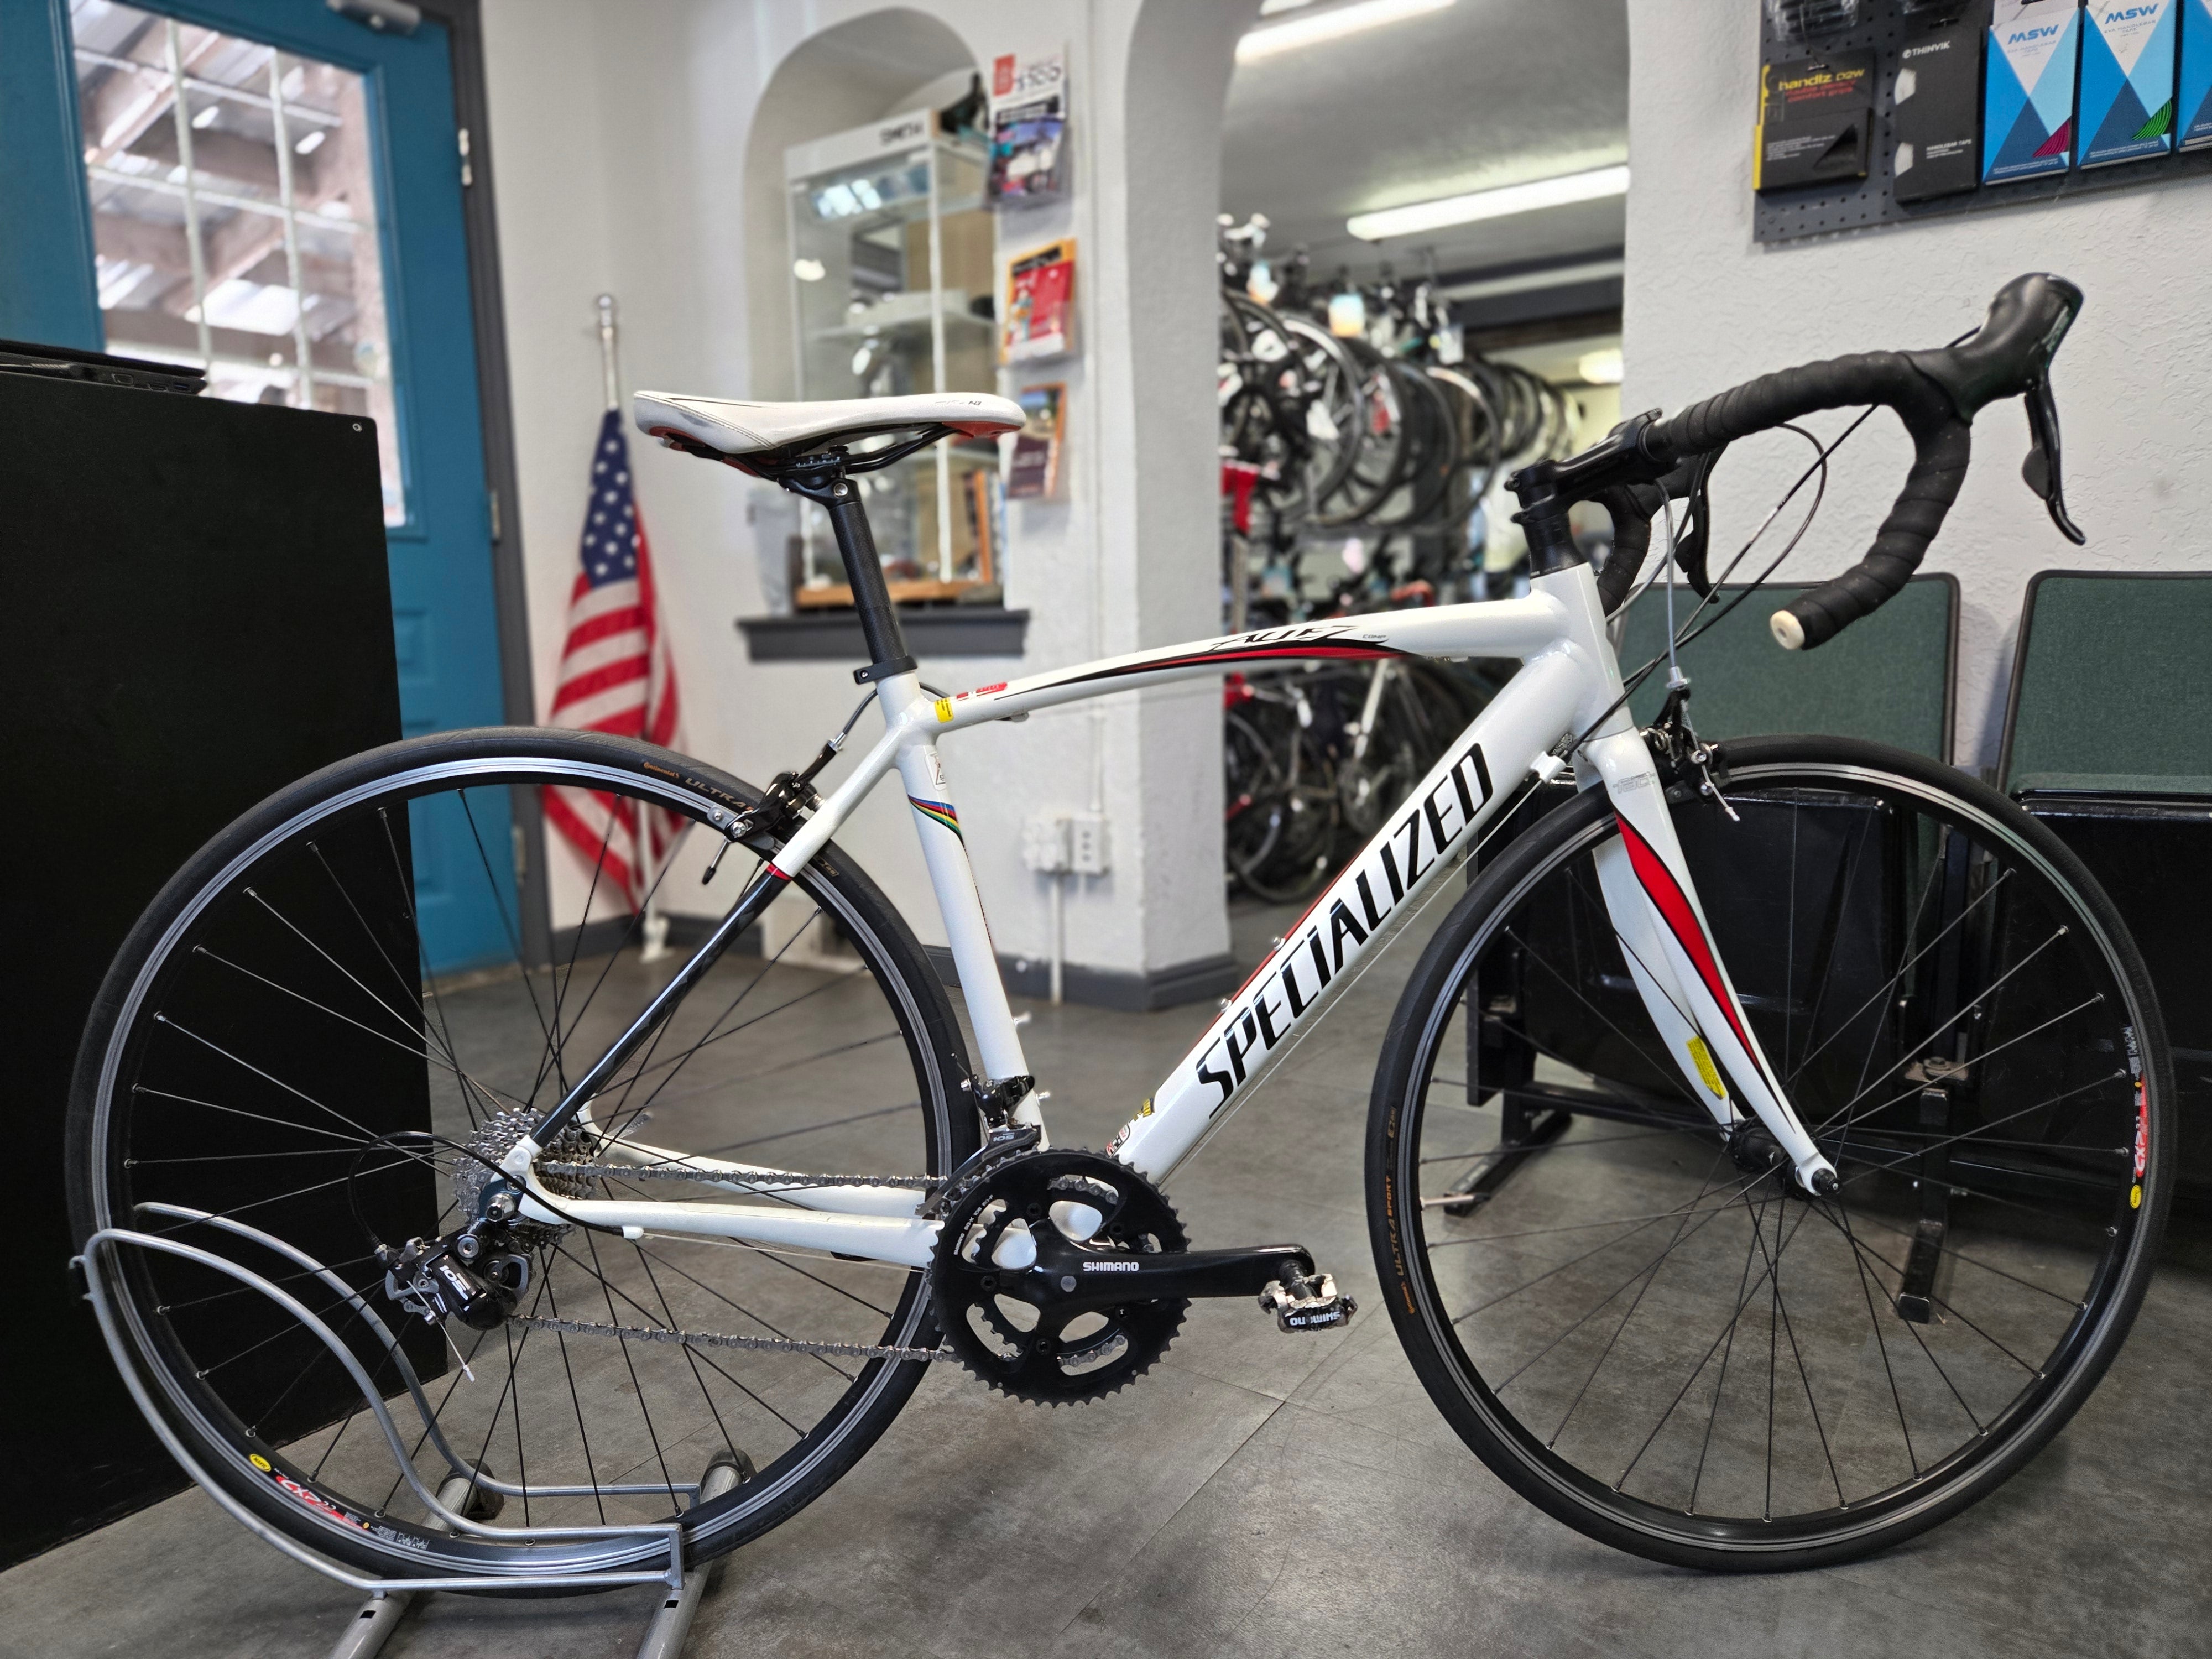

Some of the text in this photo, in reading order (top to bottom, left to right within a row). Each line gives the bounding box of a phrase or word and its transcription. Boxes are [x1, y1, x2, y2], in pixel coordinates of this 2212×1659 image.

[2105, 3, 2159, 24] MSW
[2007, 24, 2059, 45] MSW
[685, 777, 749, 808] ULTRA
[1196, 742, 1494, 1120] SPECIALIZED
[1388, 1218, 1404, 1276] ULTRA
[1083, 1261, 1139, 1272] SHIMANO
